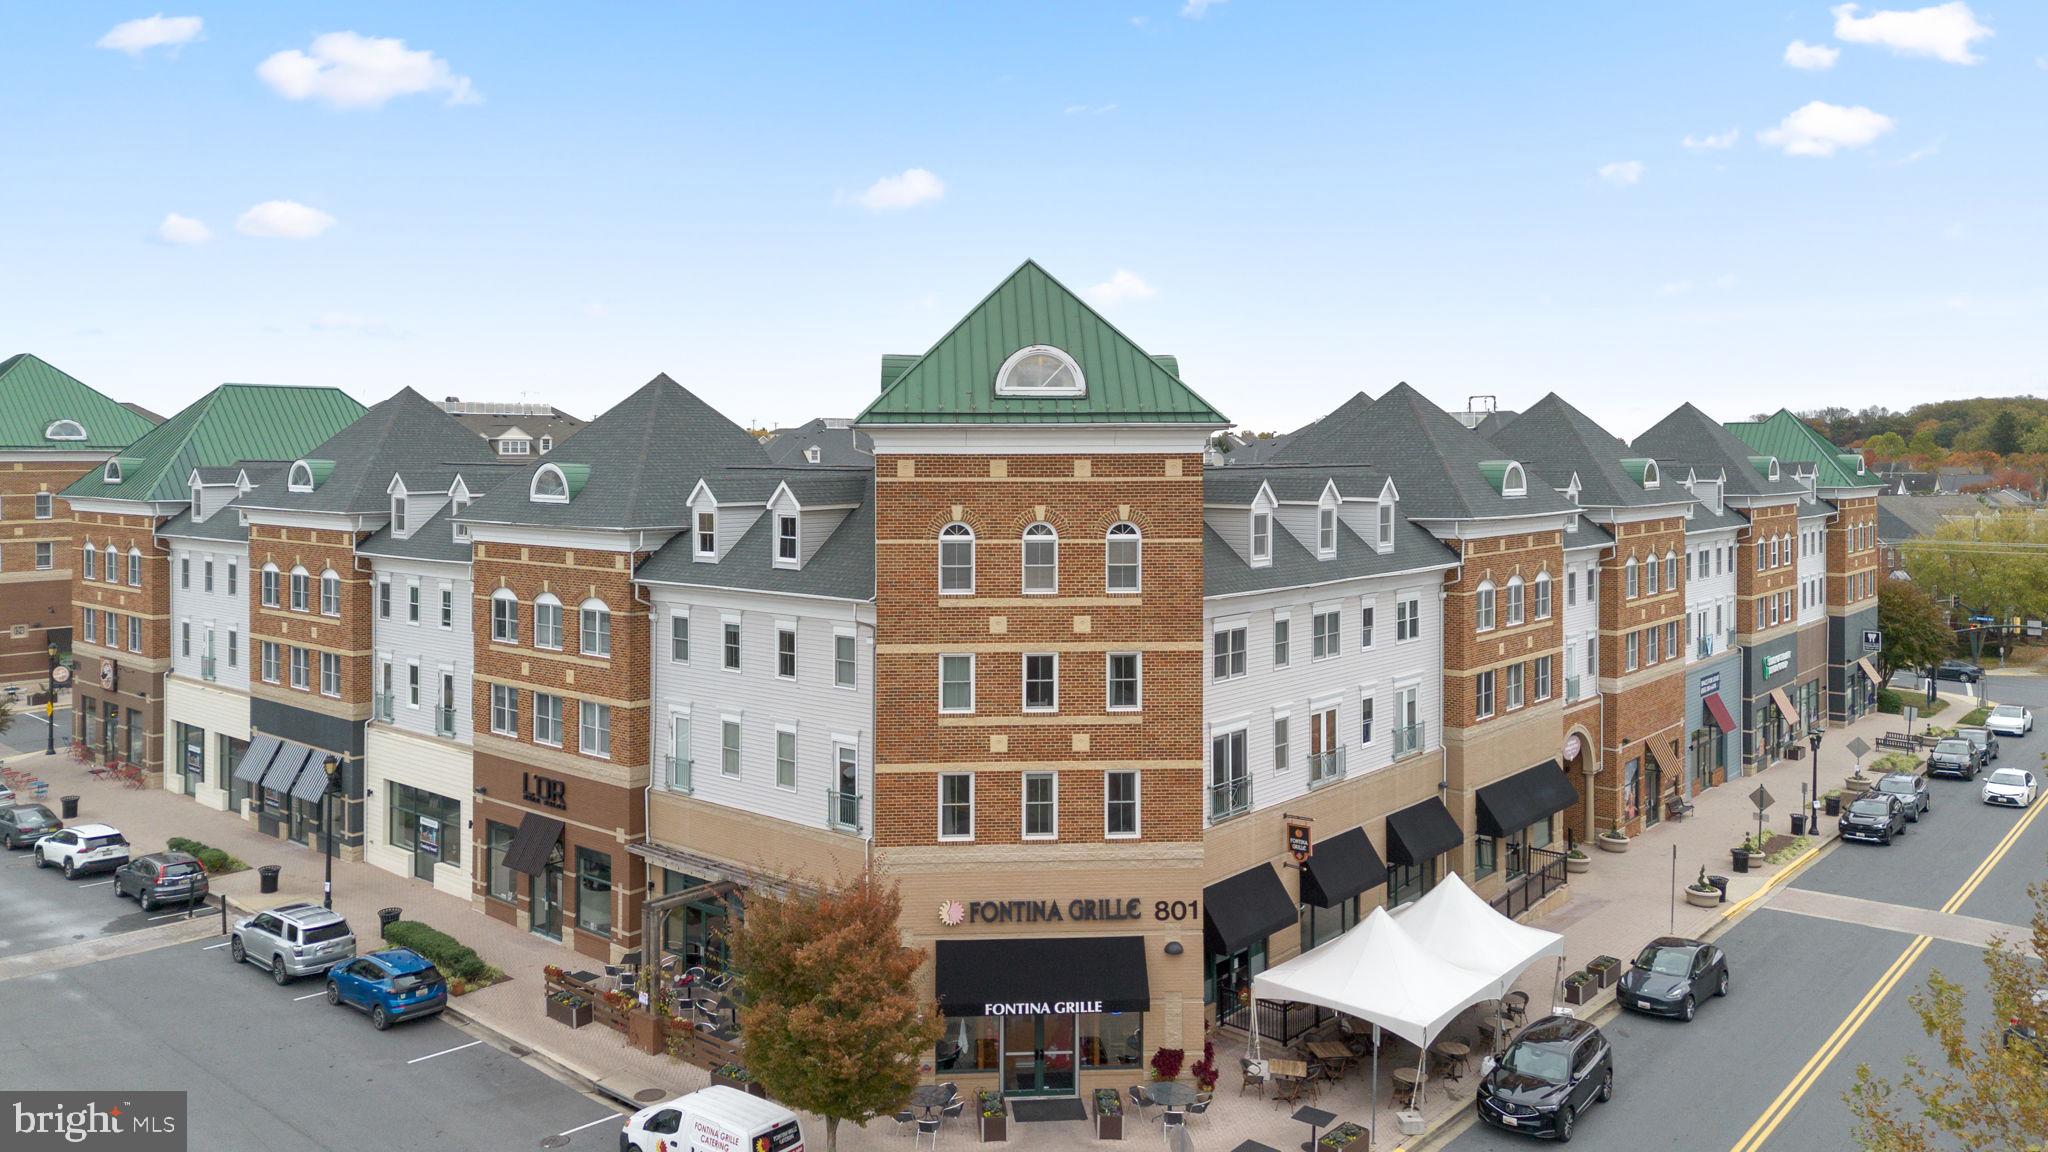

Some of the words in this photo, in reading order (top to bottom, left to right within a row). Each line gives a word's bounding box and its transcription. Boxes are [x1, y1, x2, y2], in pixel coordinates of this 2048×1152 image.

[969, 899, 1063, 923] FONTINA
[1068, 898, 1142, 921] GRILLE
[1154, 900, 1198, 921] 801
[985, 1002, 1051, 1015] FONTINA
[1054, 1001, 1103, 1014] GRILLE
[694, 1121, 719, 1138] FONTINA
[720, 1132, 740, 1146] GRILLE
[700, 1134, 730, 1152] CATERING
